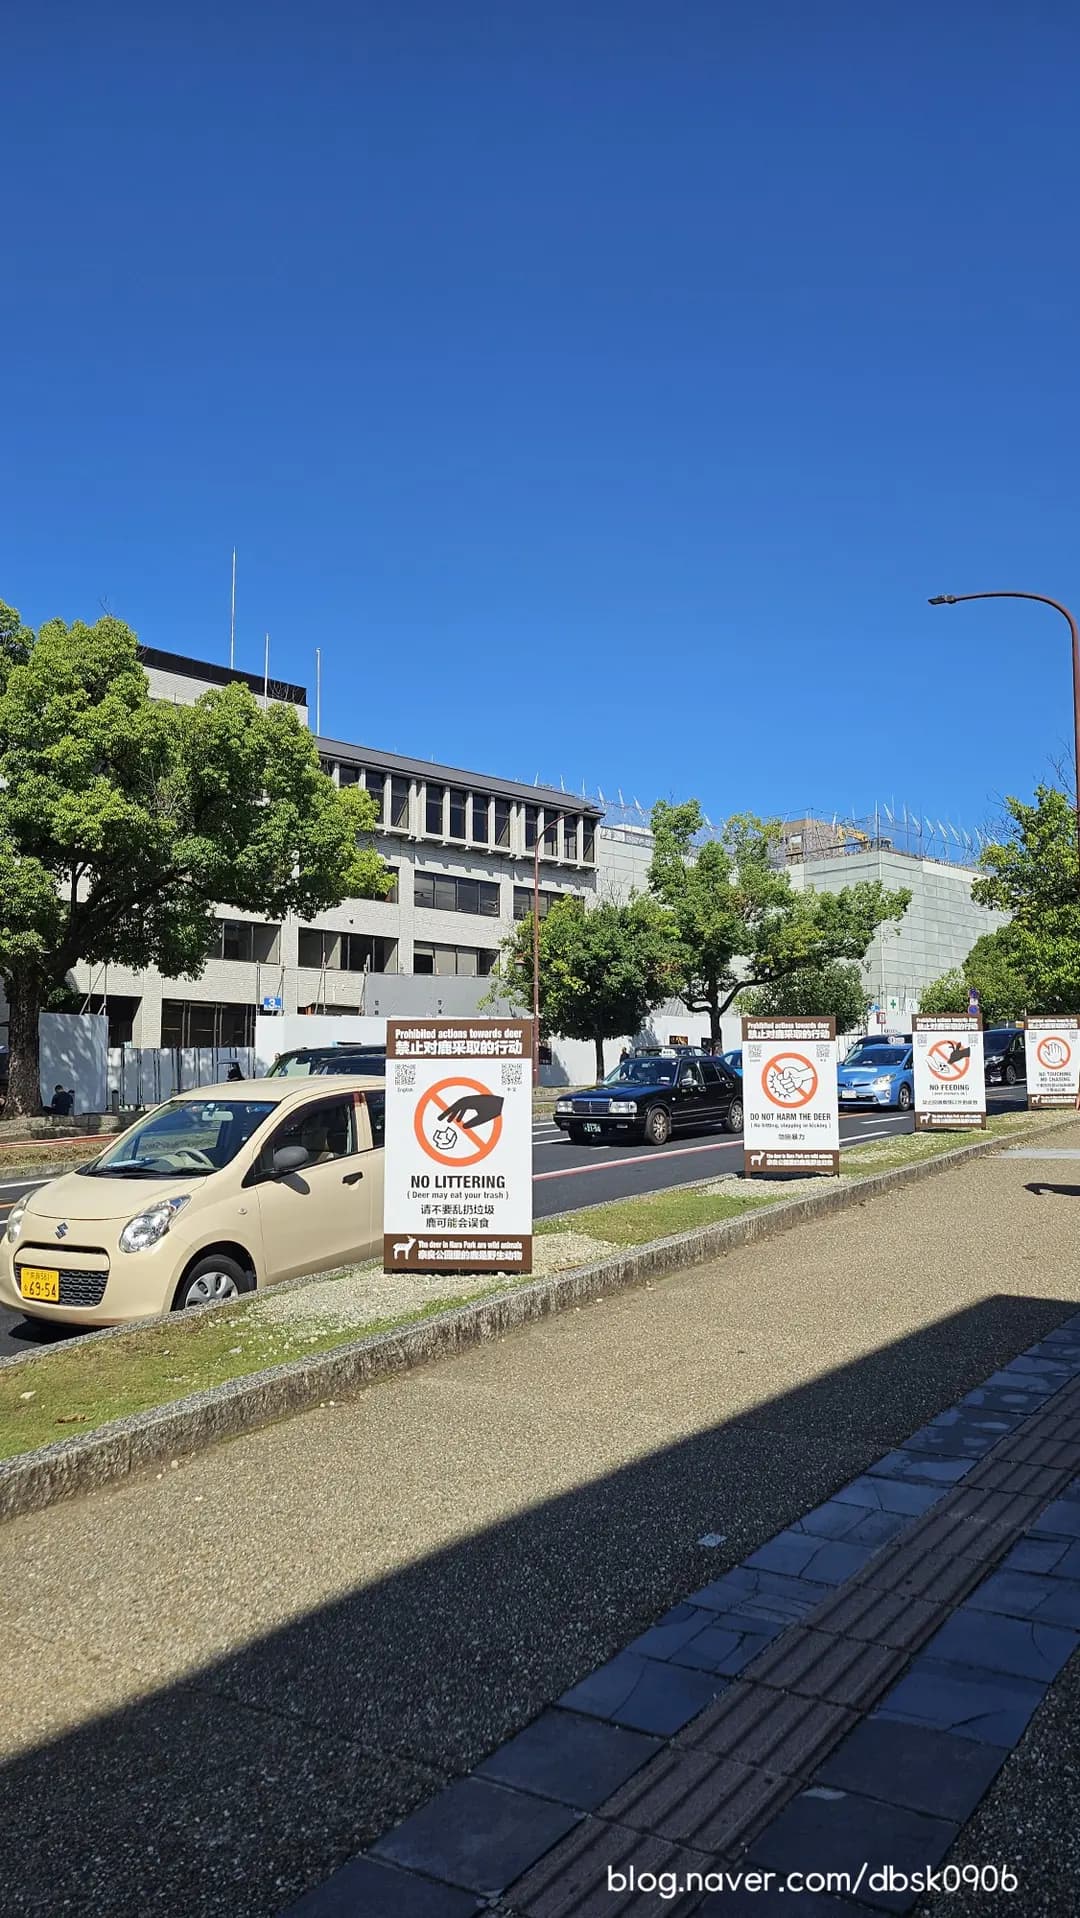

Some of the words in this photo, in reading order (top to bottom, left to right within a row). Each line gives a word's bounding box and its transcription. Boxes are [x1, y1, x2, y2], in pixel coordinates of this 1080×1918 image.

[395, 1028, 436, 1039] Prohibited
[438, 1029, 467, 1039] actions
[470, 1029, 501, 1039] towards
[504, 1029, 522, 1039] deer
[395, 1040, 522, 1055] 禁止对鹿采取的行动
[411, 1175, 430, 1188] NO
[435, 1175, 505, 1188] LITTERING
[432, 1192, 447, 1200] may
[450, 1191, 462, 1199] eat
[465, 1192, 481, 1200] your
[421, 1204, 495, 1215] 请不要乱扔垃圾
[426, 1217, 489, 1228] 鹿可能会误食
